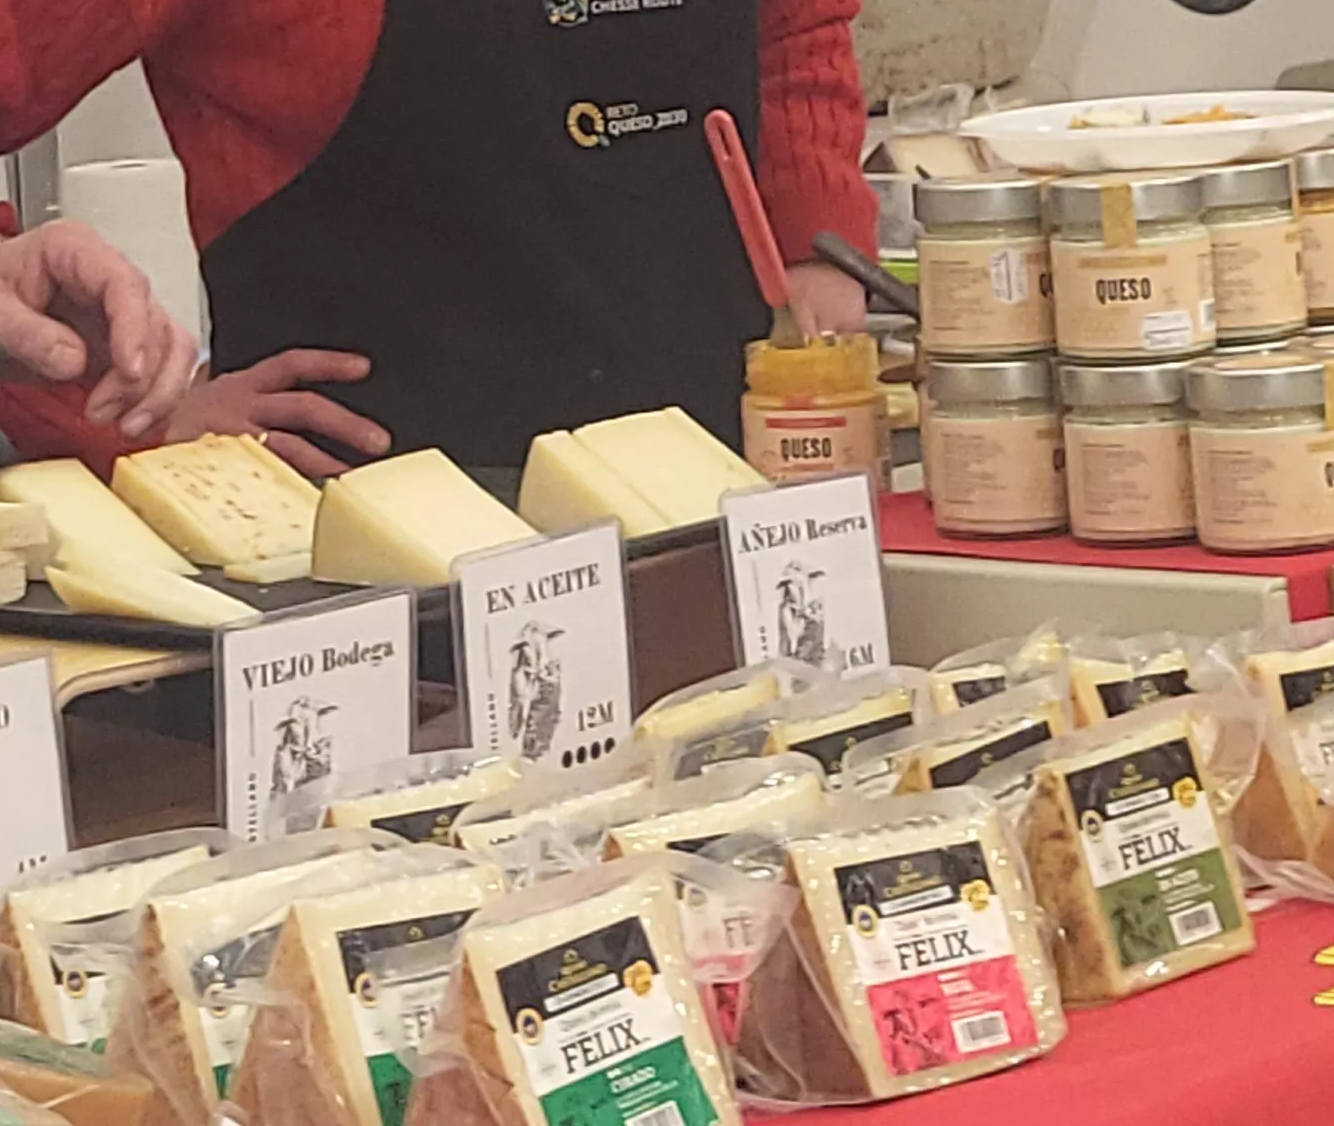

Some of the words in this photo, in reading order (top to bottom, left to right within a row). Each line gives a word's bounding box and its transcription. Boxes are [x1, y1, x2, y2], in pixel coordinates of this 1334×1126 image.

[1095, 277, 1152, 304] QUESO
[779, 437, 832, 461] QUESO
[738, 522, 802, 554] AÑEJO
[805, 514, 868, 541] Reserva
[486, 585, 516, 614] EN
[523, 563, 601, 604] ACEITE
[242, 654, 314, 692] VIEJO
[321, 641, 395, 673] Bodega
